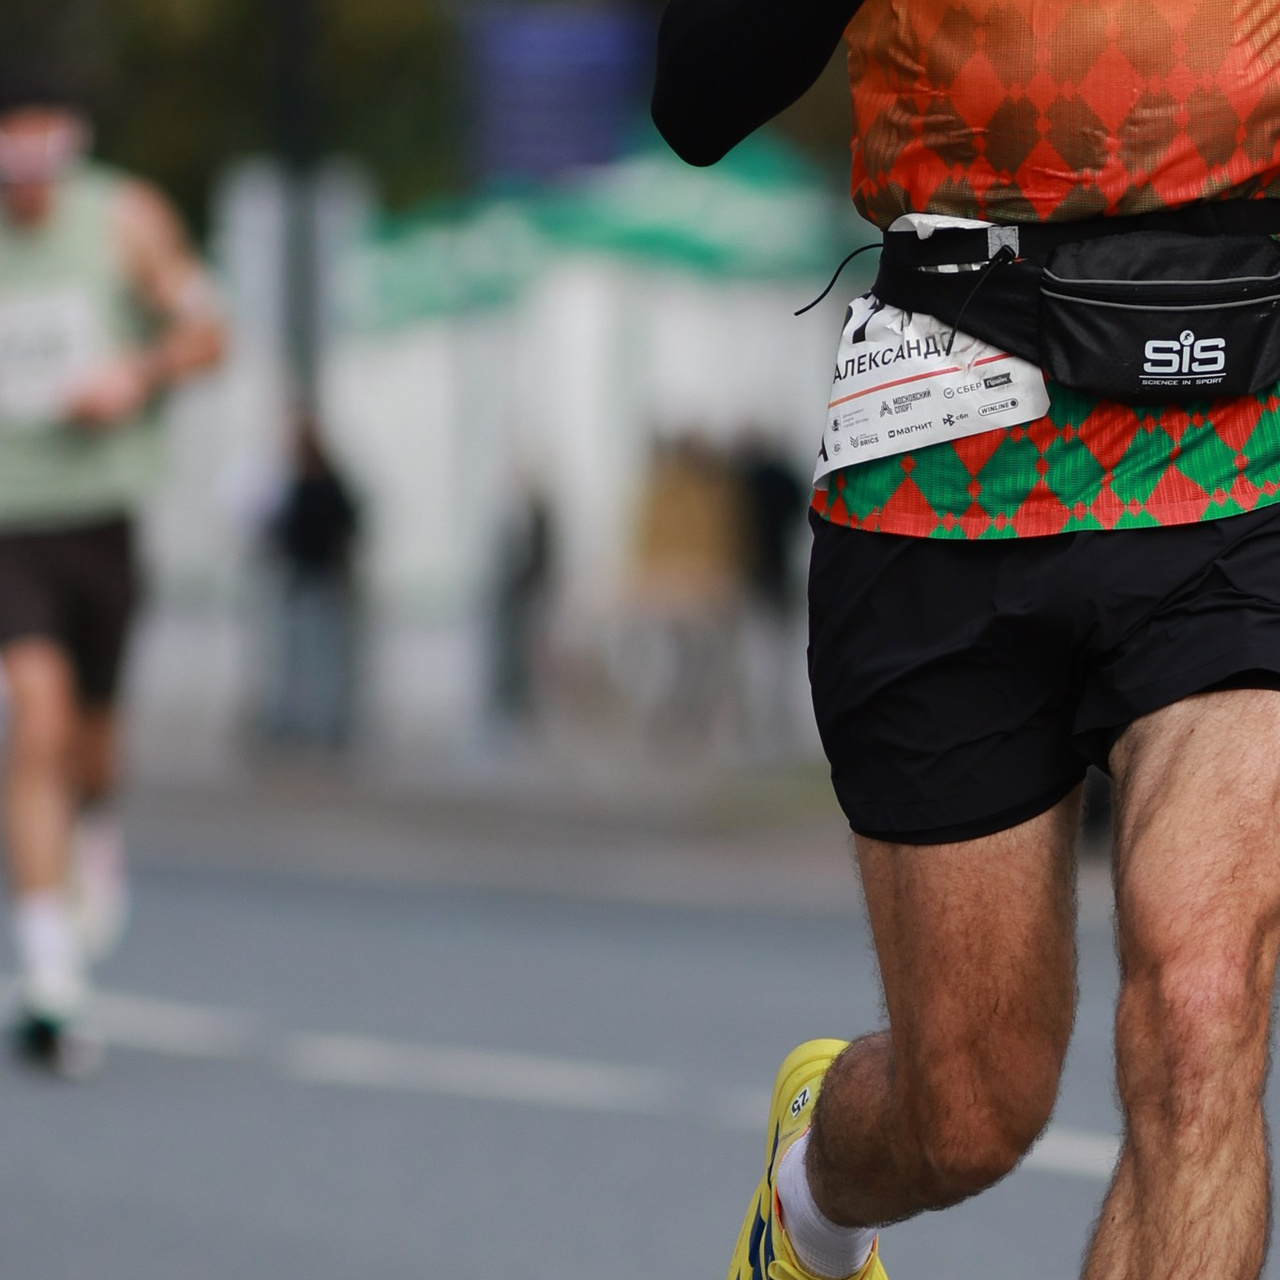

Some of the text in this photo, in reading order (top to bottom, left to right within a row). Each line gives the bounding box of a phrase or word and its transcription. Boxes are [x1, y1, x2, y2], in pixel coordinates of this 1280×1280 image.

[1196, 377, 1223, 385] SPORT
[956, 381, 982, 395] СБЕР
[892, 388, 932, 405] МОСКОВСКИЙ
[894, 402, 913, 414] СПОРТ
[981, 402, 1009, 414] WINLINE
[859, 436, 880, 447] BRICS
[791, 1088, 809, 1118] 25
